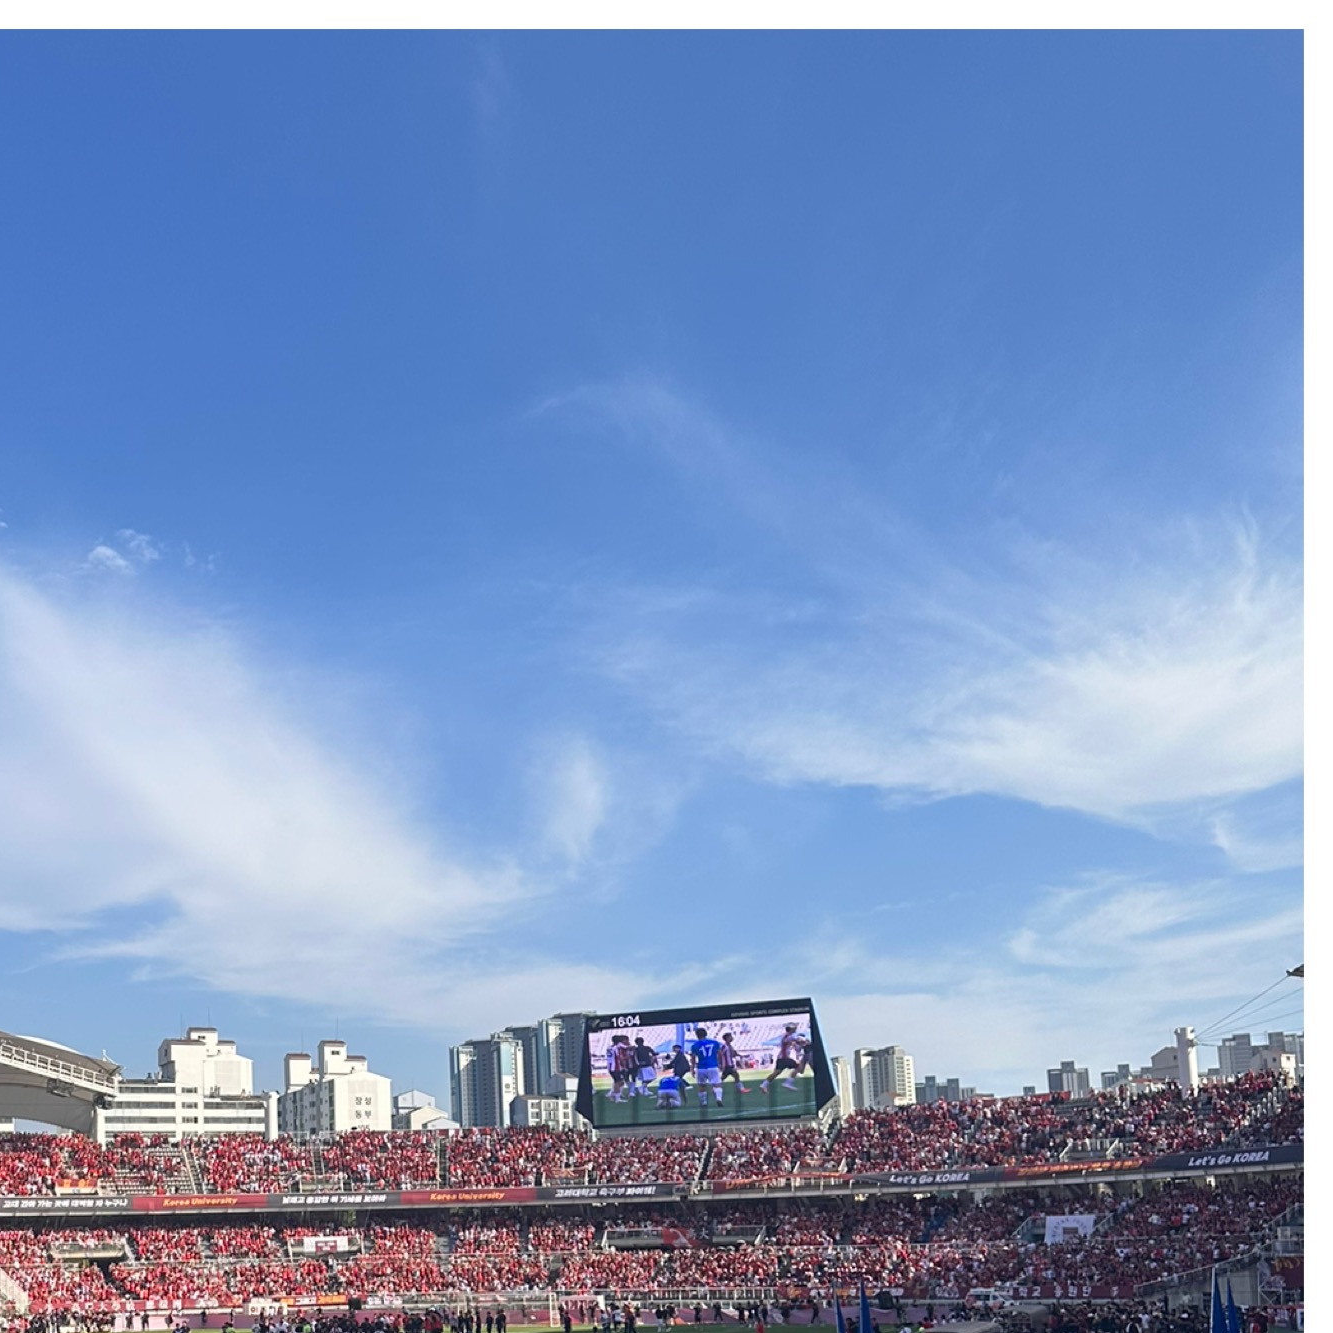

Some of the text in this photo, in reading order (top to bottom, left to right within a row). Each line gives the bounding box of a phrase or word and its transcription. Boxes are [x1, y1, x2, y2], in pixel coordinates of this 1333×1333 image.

[1188, 1150, 1270, 1167] Let's Go KOREA
[889, 1172, 971, 1185] Let's Go KOREA
[430, 1190, 506, 1200] Korea University
[163, 1196, 238, 1206] Korea University
